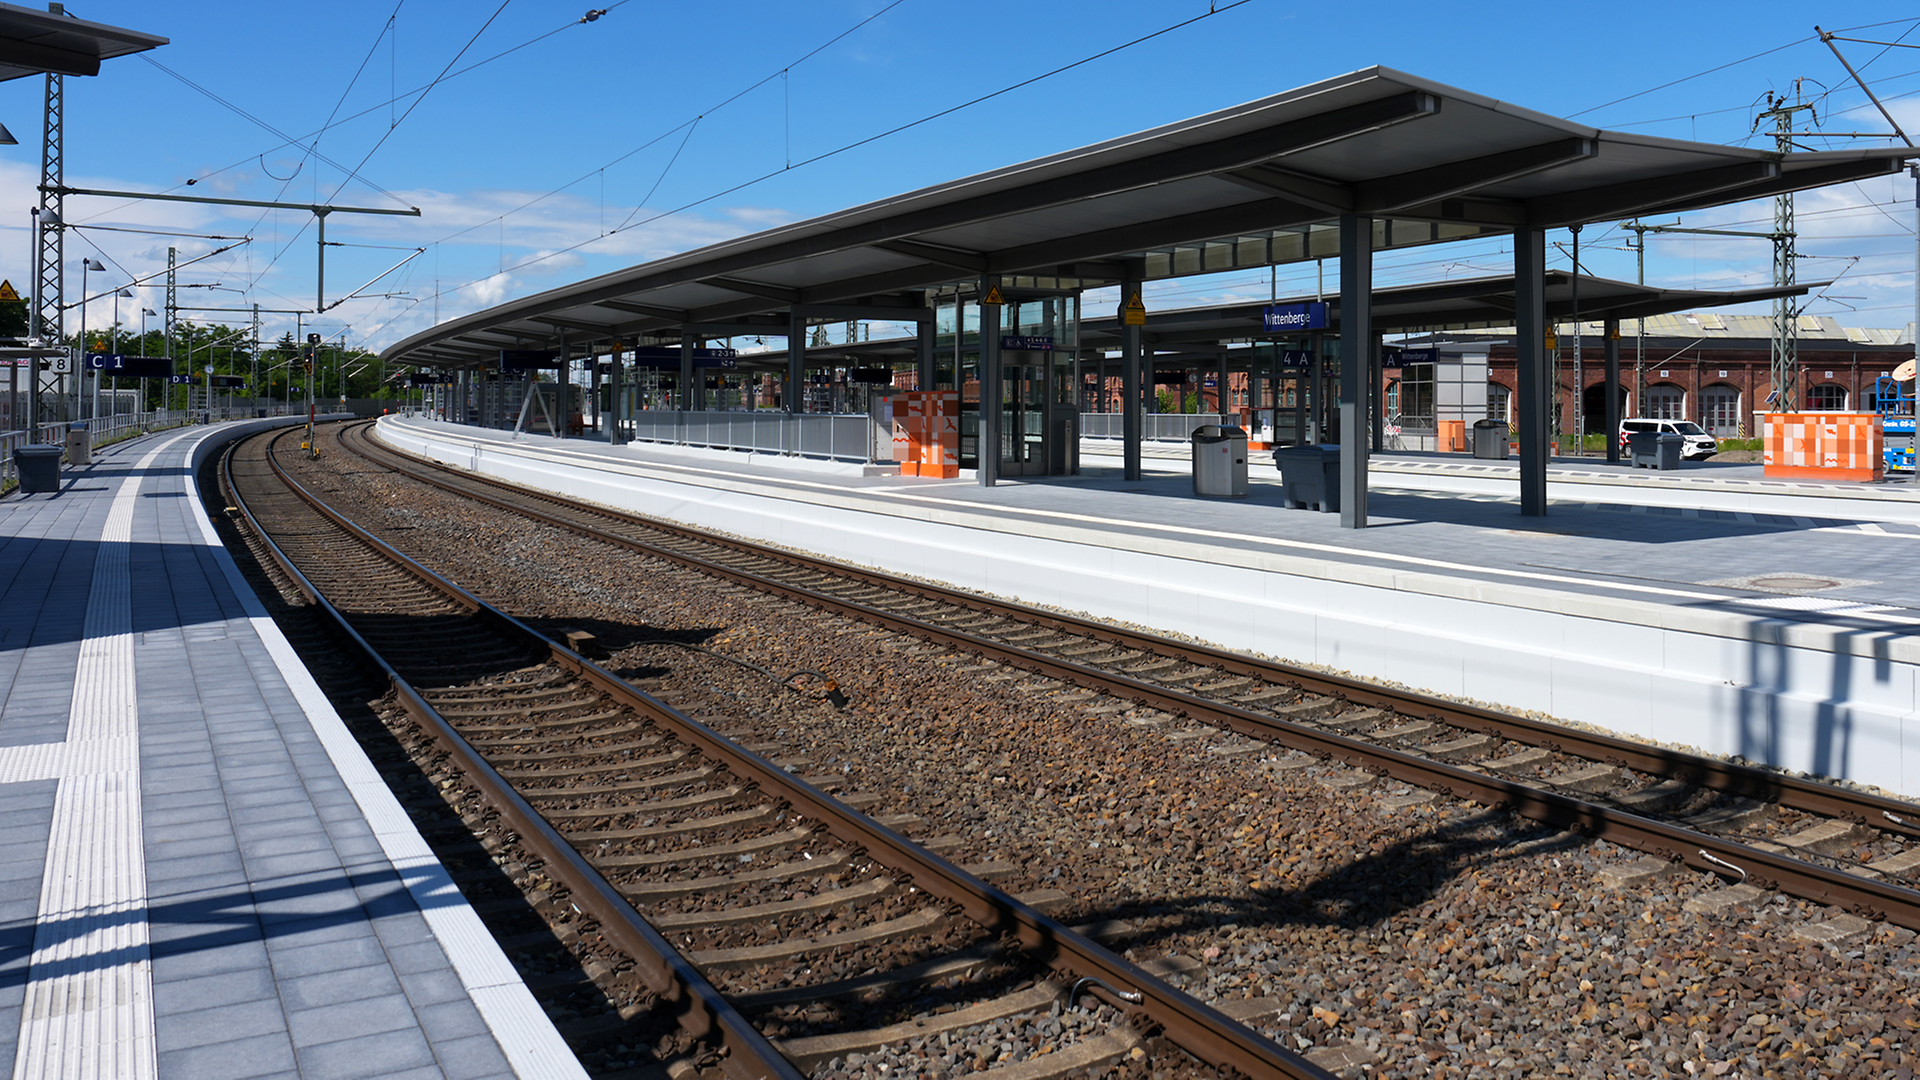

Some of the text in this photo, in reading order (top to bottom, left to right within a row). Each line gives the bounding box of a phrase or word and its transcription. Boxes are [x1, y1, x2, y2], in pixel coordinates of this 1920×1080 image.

[1264, 311, 1311, 326] Wittenberge
[56, 359, 66, 370] 8
[92, 356, 122, 368] C 1
[1283, 352, 1309, 365] 4 A
[1386, 354, 1396, 367] A
